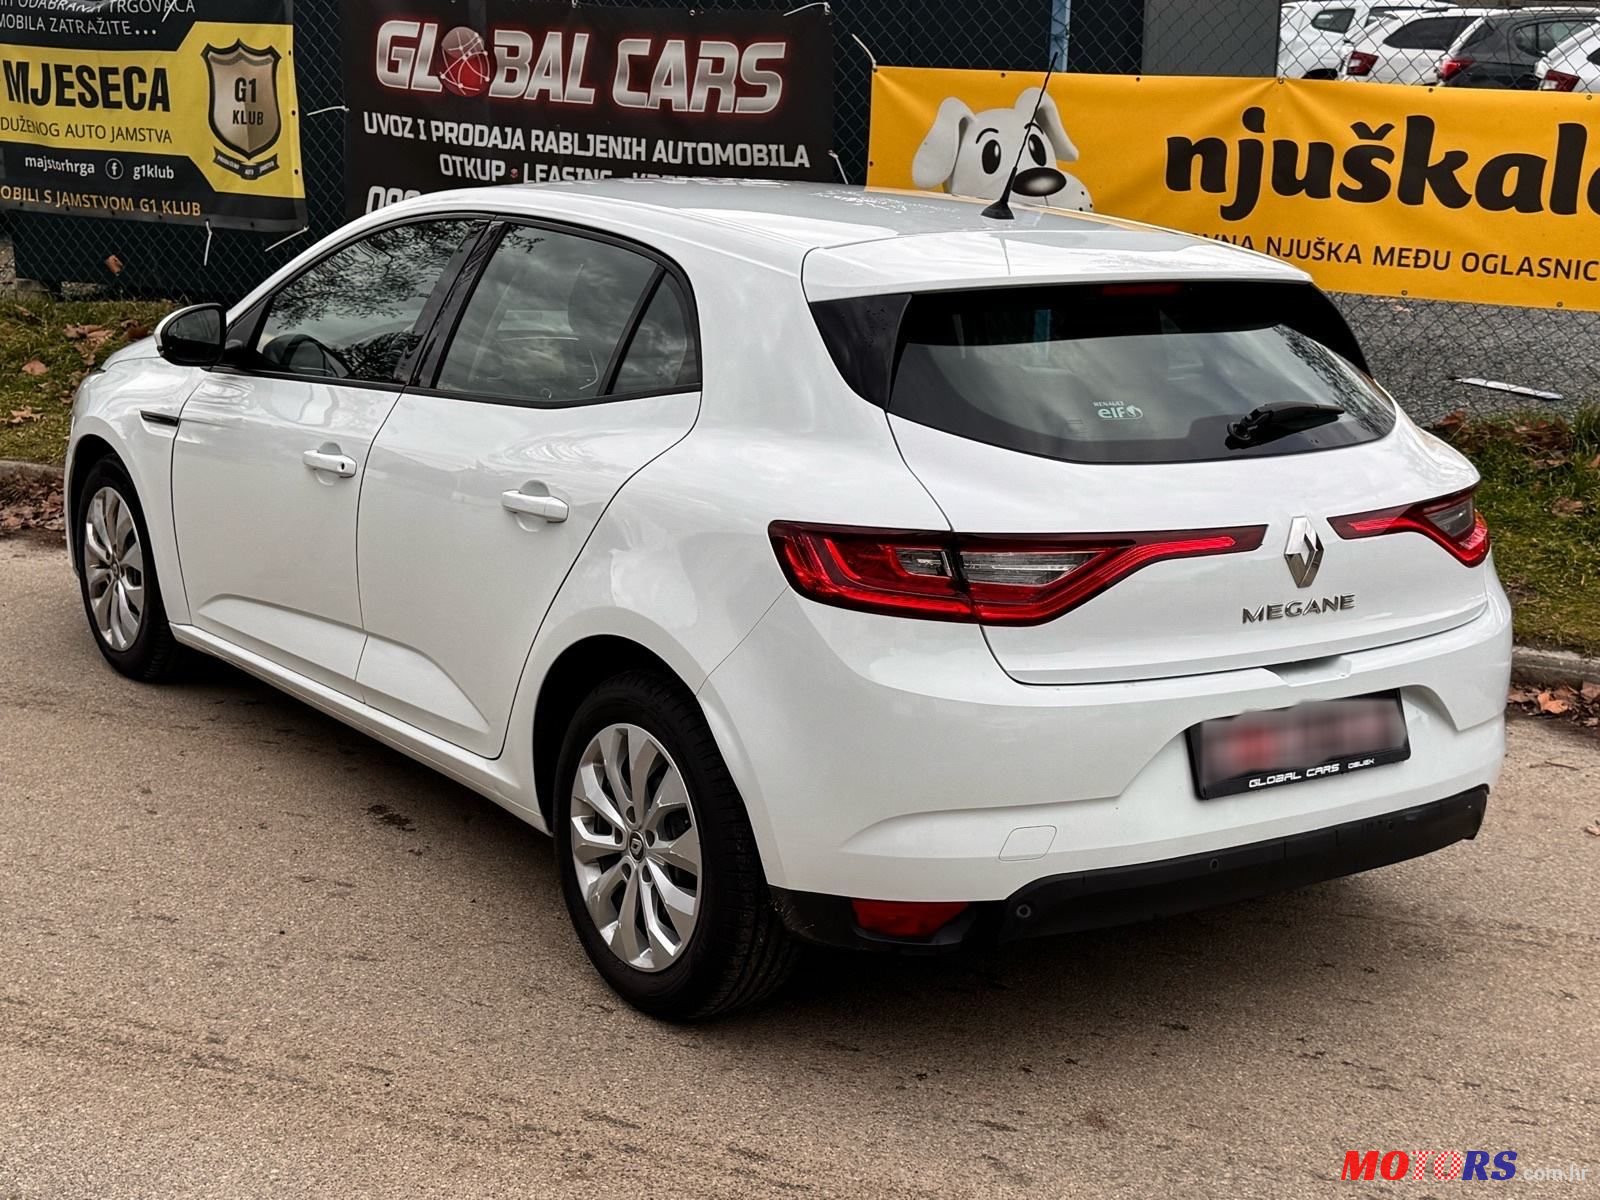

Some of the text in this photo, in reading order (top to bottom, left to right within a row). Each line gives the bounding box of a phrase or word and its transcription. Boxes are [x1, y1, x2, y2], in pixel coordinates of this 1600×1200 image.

[49, 17, 157, 36] ZATRAŽITE...
[2, 60, 171, 112] MJESECA
[234, 77, 257, 103] G1
[613, 38, 786, 114] CARS
[0, 116, 172, 144] DUŽENOG AUTO JAMSTVA
[232, 109, 264, 126] KLUB
[363, 111, 811, 168] UVOZ I PRODAJA RABLJENIH AUTOMOBILA
[25, 156, 95, 177] majstorhrga
[133, 165, 175, 181] g1klub
[439, 153, 506, 182] OTKUP
[1165, 106, 1600, 221] njuškal
[0, 185, 201, 217] OBILI S JAMSTVOM G1 KLUB
[1266, 236, 1362, 264] NJUŠKA
[1373, 245, 1451, 270] MEĐU
[1461, 252, 1600, 281] OGLASNIC
[1098, 406, 1125, 419] elf
[1242, 594, 1356, 624] MEGANE
[1249, 771, 1302, 788] GLOBAL
[1306, 763, 1340, 778] CARS
